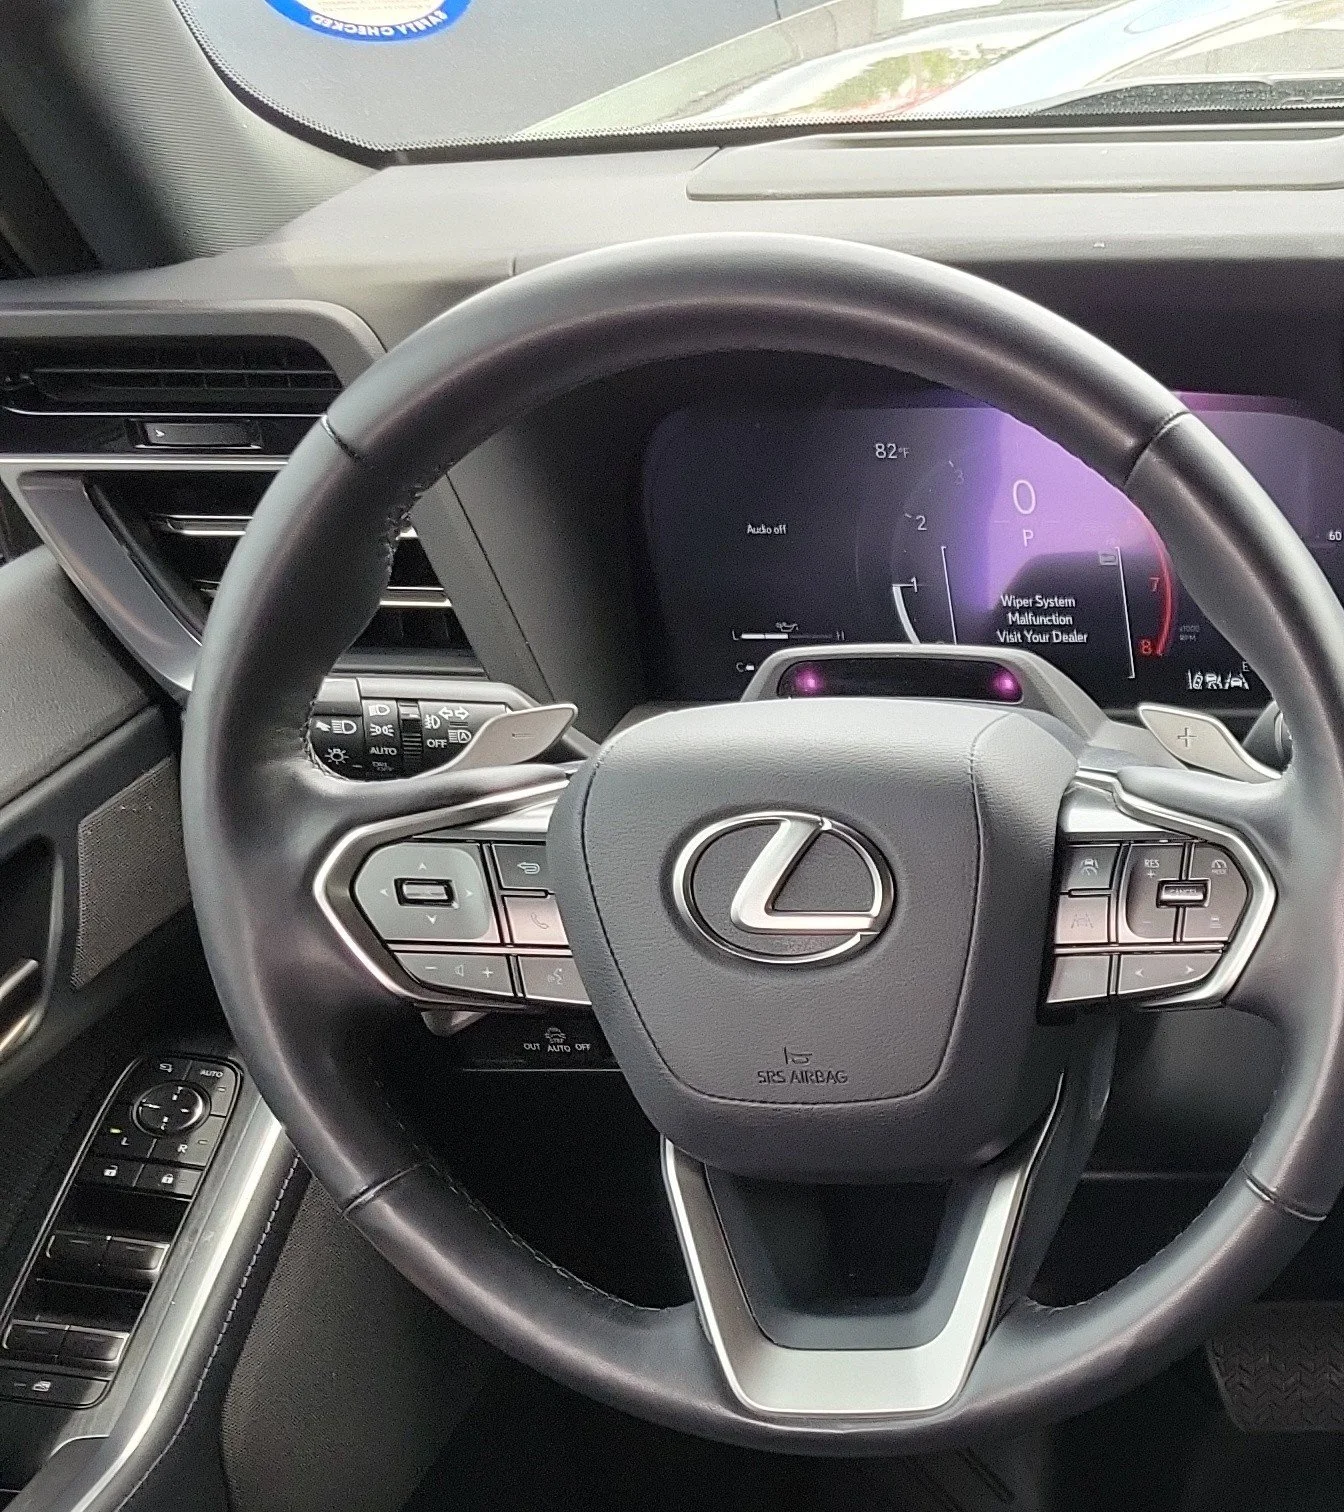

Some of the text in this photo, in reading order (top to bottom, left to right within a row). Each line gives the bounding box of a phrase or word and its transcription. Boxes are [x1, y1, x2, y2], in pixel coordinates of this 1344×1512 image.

[1012, 479, 1037, 515] 0
[915, 514, 928, 531] 2
[746, 523, 787, 535] Audio off
[1022, 528, 1034, 547] P
[1327, 530, 1342, 542] 60
[910, 576, 918, 593] 1
[1150, 577, 1160, 592] 7
[1000, 594, 1076, 609] Wiper System
[1007, 611, 1073, 625] Malfunction
[996, 628, 1088, 643] Visit Your Dealer
[1140, 638, 1152, 654] 8
[1241, 661, 1250, 672] E
[426, 739, 448, 748] OFF
[369, 746, 397, 756] AUTO
[1144, 859, 1160, 868] RES
[523, 1043, 540, 1051] OUT
[547, 1044, 571, 1053] AUTO
[574, 1043, 591, 1051] OFF
[199, 1069, 224, 1078] AUTO
[756, 1070, 849, 1085] SRS AIRBAG
[177, 1143, 188, 1154] R
